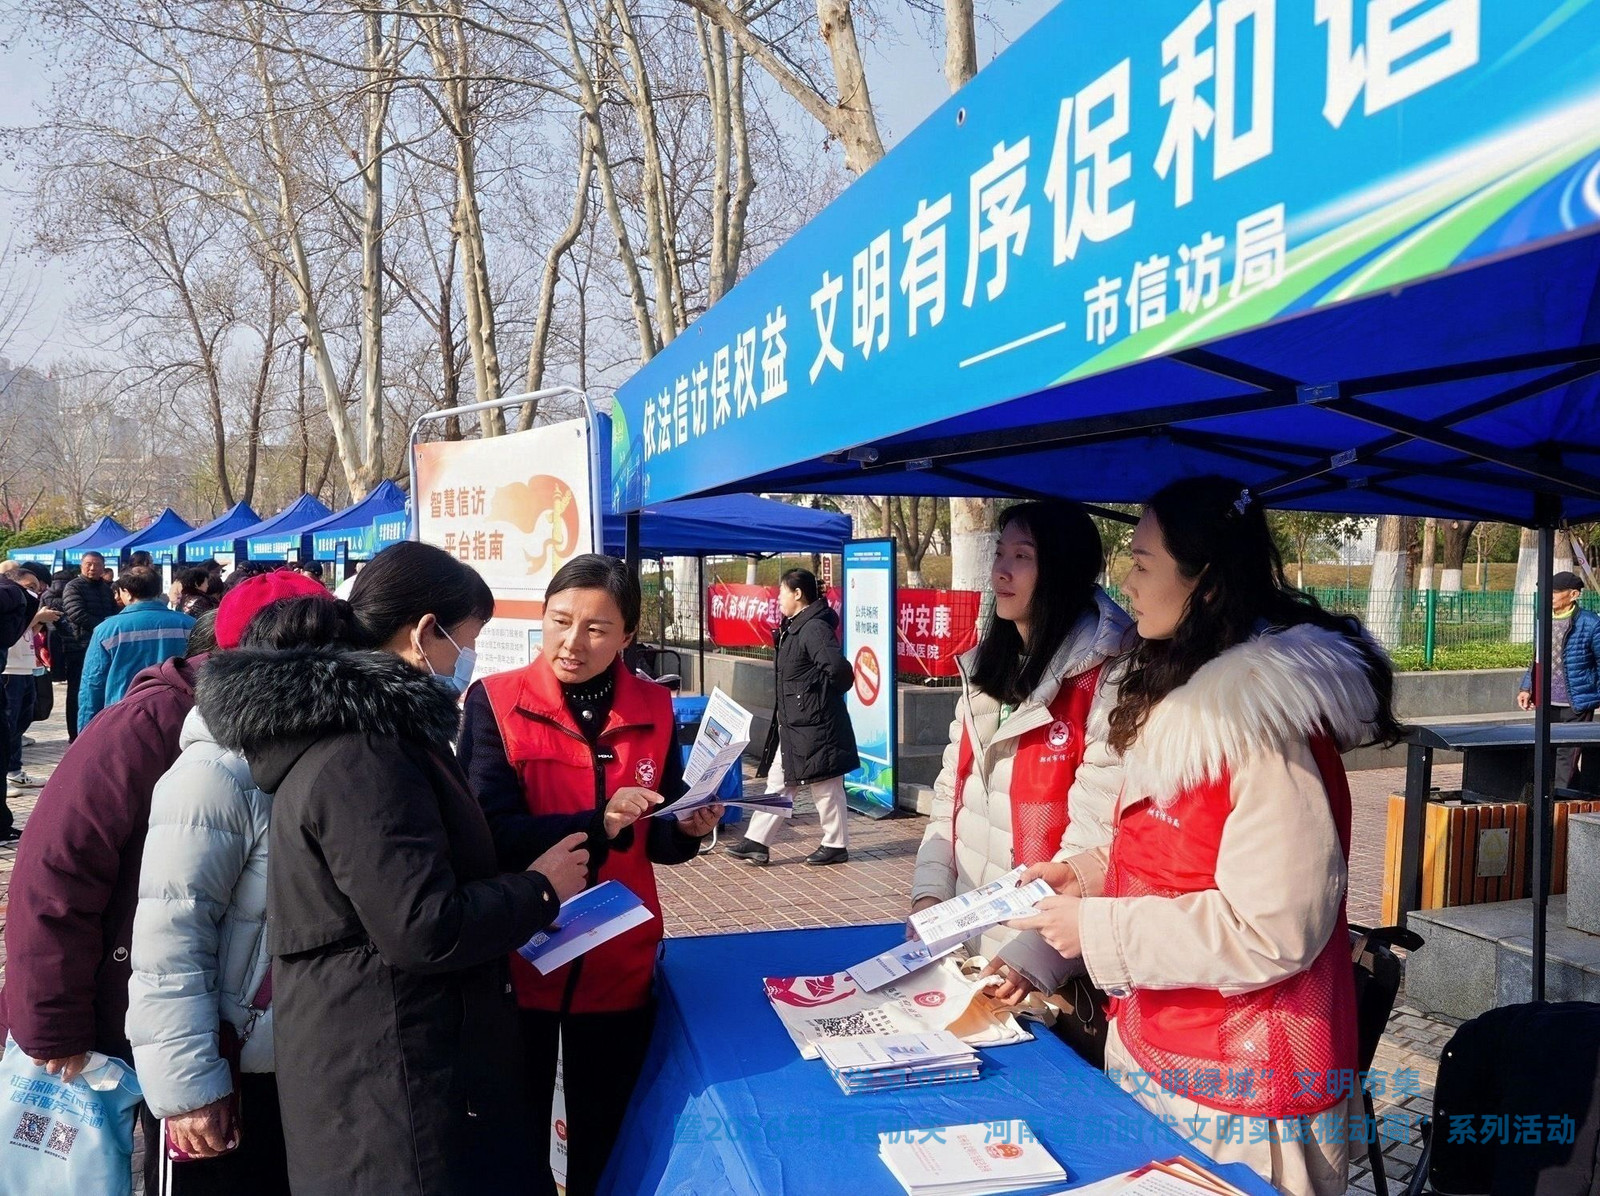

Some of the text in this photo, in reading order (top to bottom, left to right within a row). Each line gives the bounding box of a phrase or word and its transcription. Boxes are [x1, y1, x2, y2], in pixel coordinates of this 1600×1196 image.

[1084, 202, 1286, 345] 市信访局
[643, 305, 788, 462] 依法信访保权益
[431, 485, 486, 518] 智慧信访
[444, 530, 504, 561] 平台指南
[855, 605, 879, 619] 公共场所
[855, 620, 879, 635] 请勿吸烟
[900, 603, 952, 639] 护安康
[10, 1090, 104, 1129] 居民服务一卡通
